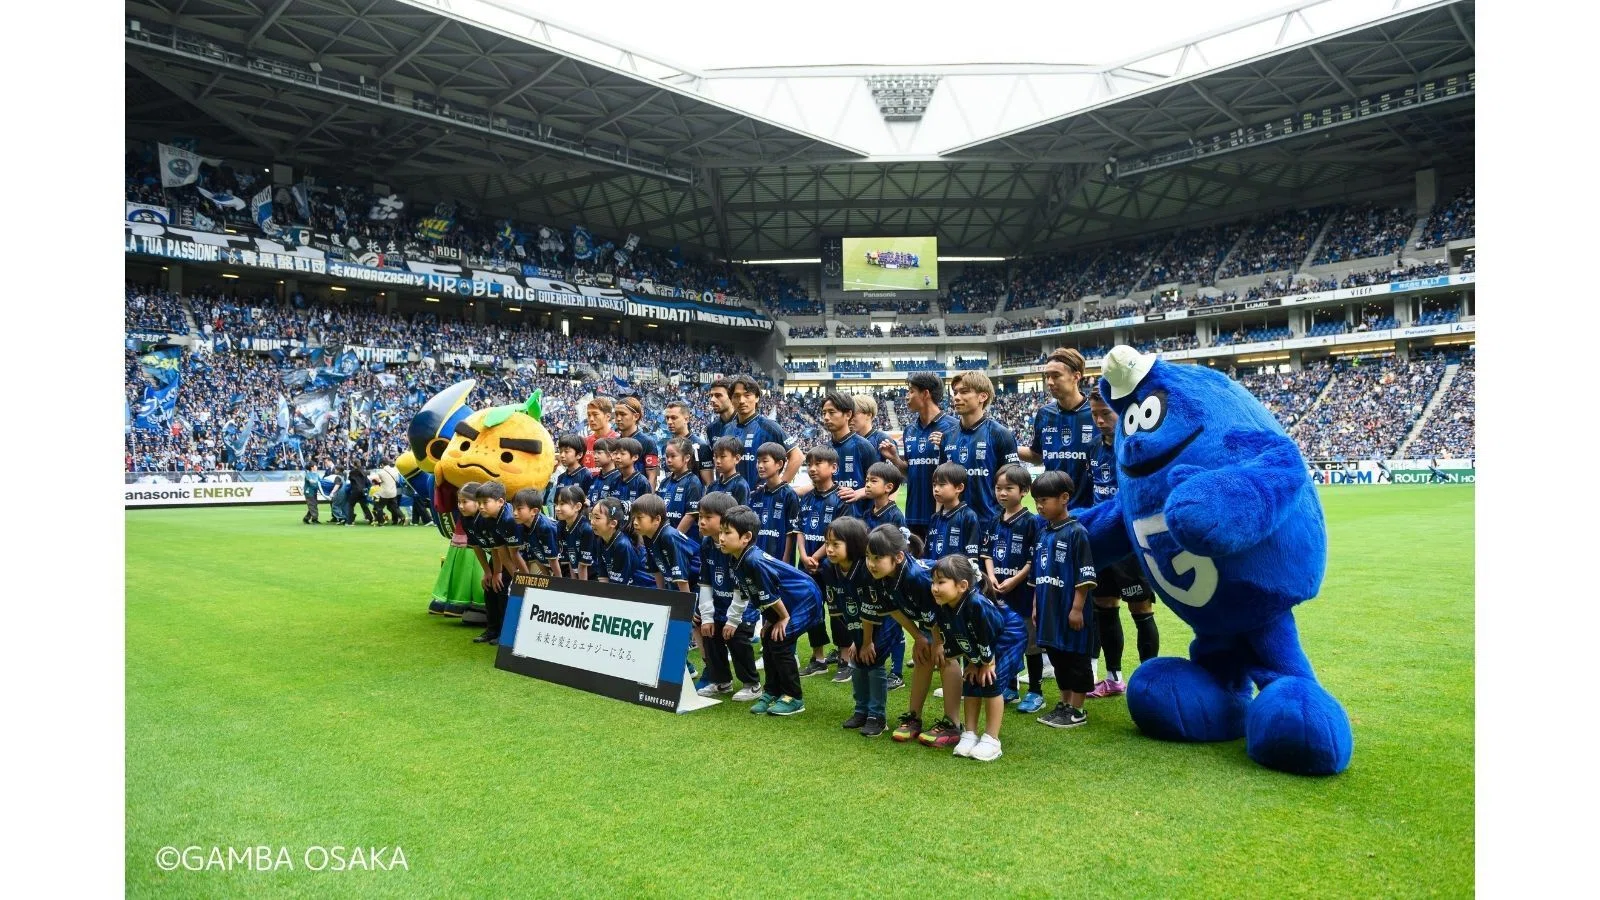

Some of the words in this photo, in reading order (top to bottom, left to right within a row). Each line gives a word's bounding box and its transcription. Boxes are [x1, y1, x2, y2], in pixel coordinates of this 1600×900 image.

[141, 236, 164, 256] TUA
[503, 284, 535, 302] RDG
[538, 291, 585, 308] GUERRIERI
[628, 303, 690, 323] DIFFIDATI
[1245, 301, 1270, 309] LUMIX
[740, 452, 755, 462] nic
[966, 467, 989, 477] onic
[193, 487, 254, 499] ENERGY
[515, 575, 538, 588] PARTNER
[538, 578, 550, 588] DAY
[529, 604, 590, 631] Panasonic
[591, 613, 654, 641] ENERGY
[535, 631, 636, 663] 未来を変えるエナジーになる。
